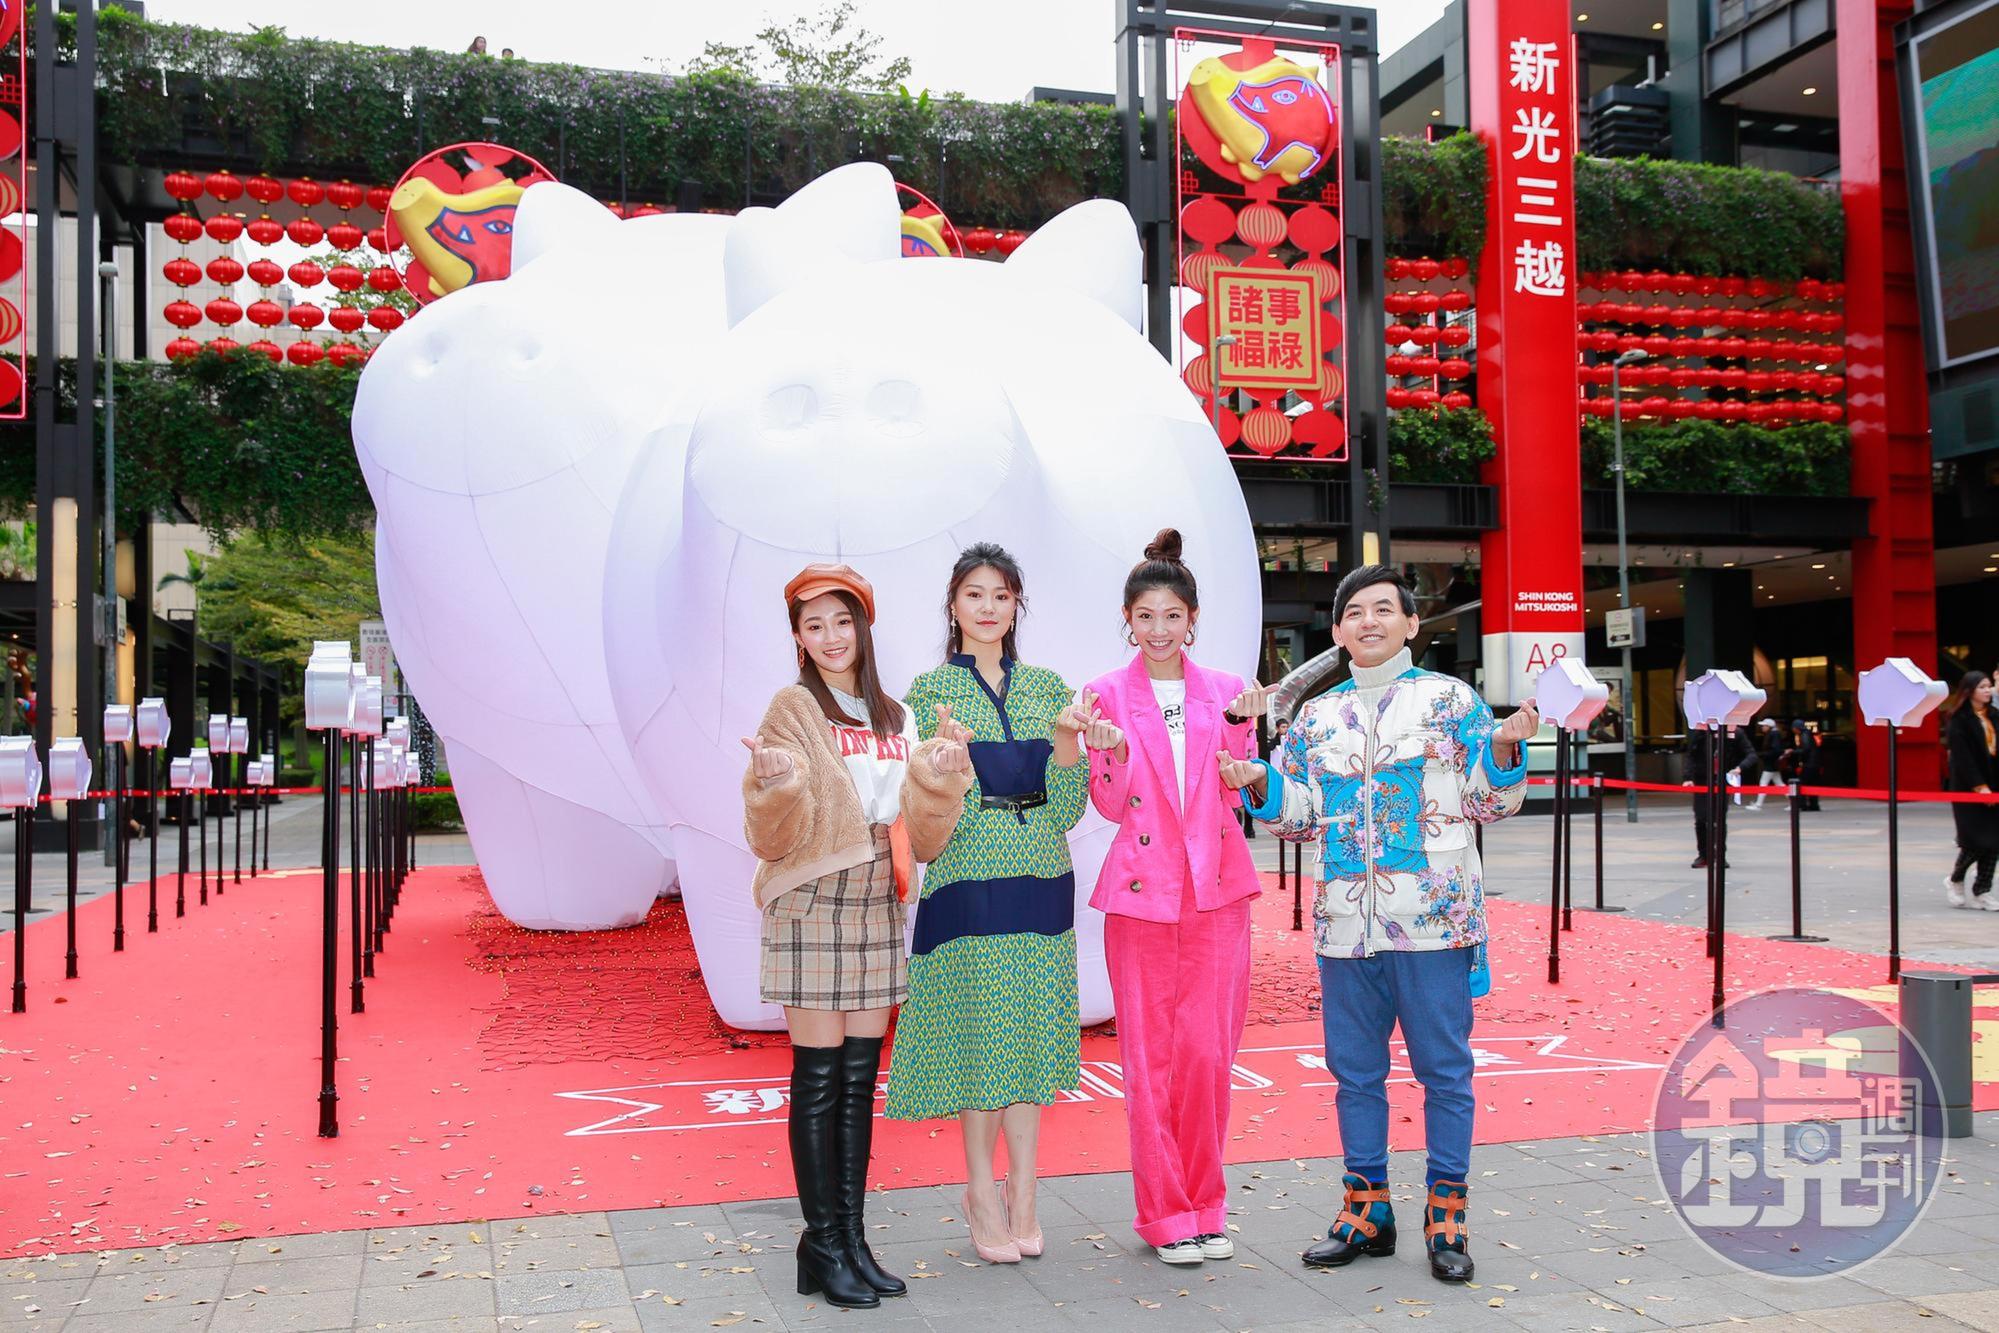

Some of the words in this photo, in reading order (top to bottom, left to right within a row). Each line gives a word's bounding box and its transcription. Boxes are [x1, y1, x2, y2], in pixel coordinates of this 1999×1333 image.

[1509, 37, 1566, 297] 新光三越
[1228, 284, 1302, 326] 諸事
[1514, 602, 1578, 612] MITSUKOSHI
[1518, 591, 1543, 601] SHIN
[1544, 591, 1574, 601] KONG
